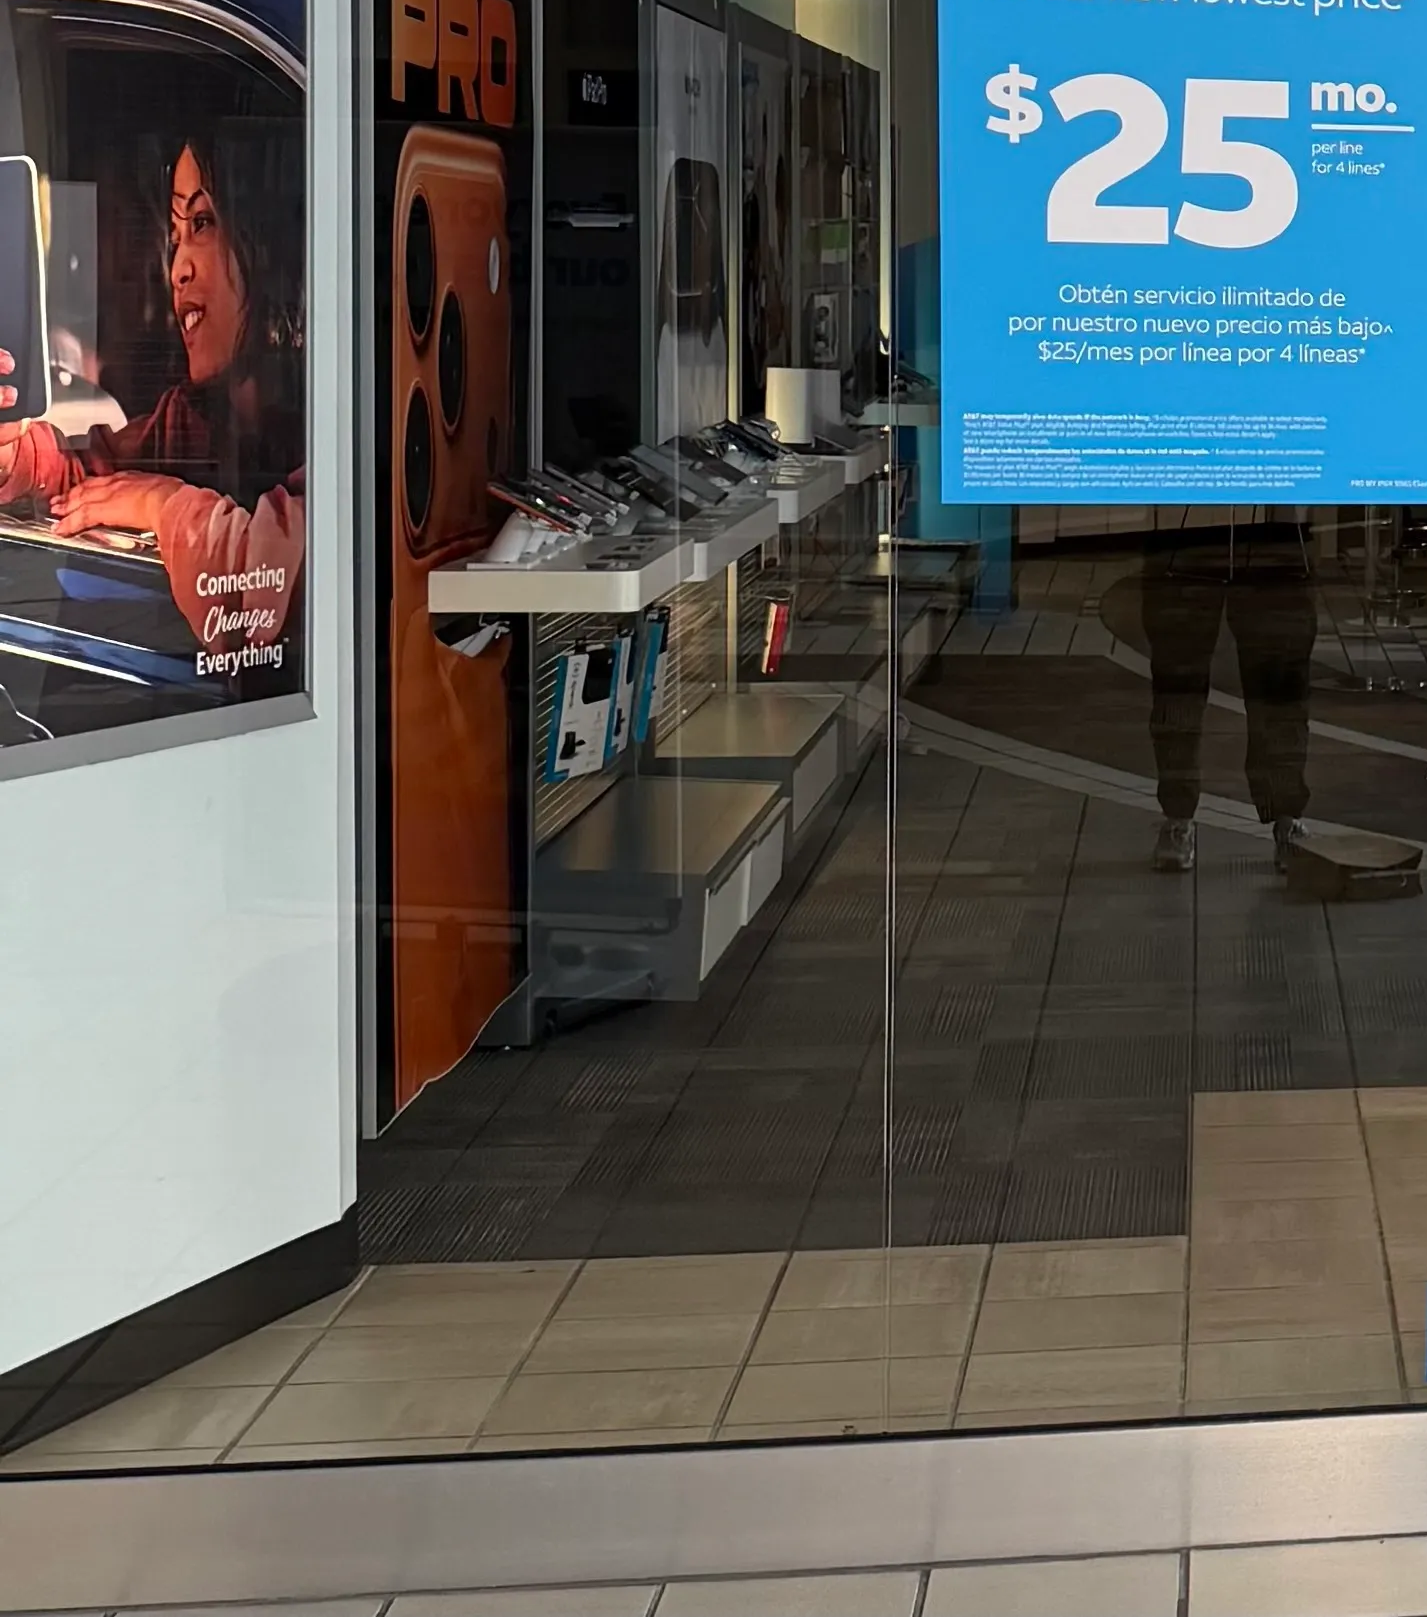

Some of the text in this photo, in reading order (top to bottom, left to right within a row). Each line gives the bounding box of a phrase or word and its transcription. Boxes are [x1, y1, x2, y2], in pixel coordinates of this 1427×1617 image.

[1311, 81, 1398, 114] mo.
[985, 63, 1299, 249] $25
[1311, 141, 1364, 157] per line
[1311, 159, 1333, 174] for
[1336, 161, 1345, 173] 4
[1059, 283, 1346, 307] Obtén servicio ilimitado de
[1008, 316, 1046, 336] por
[1052, 315, 1138, 334] nuestro
[1143, 318, 1210, 335] nuevo
[1215, 315, 1283, 338] precio
[1288, 315, 1333, 335] más
[1038, 340, 1134, 364] $25/mes
[1140, 346, 1177, 366] por
[1182, 341, 1232, 363] línea
[1238, 347, 1275, 366] por
[1280, 344, 1292, 363] 4
[196, 563, 286, 597] Connecting
[203, 604, 277, 643] Changes
